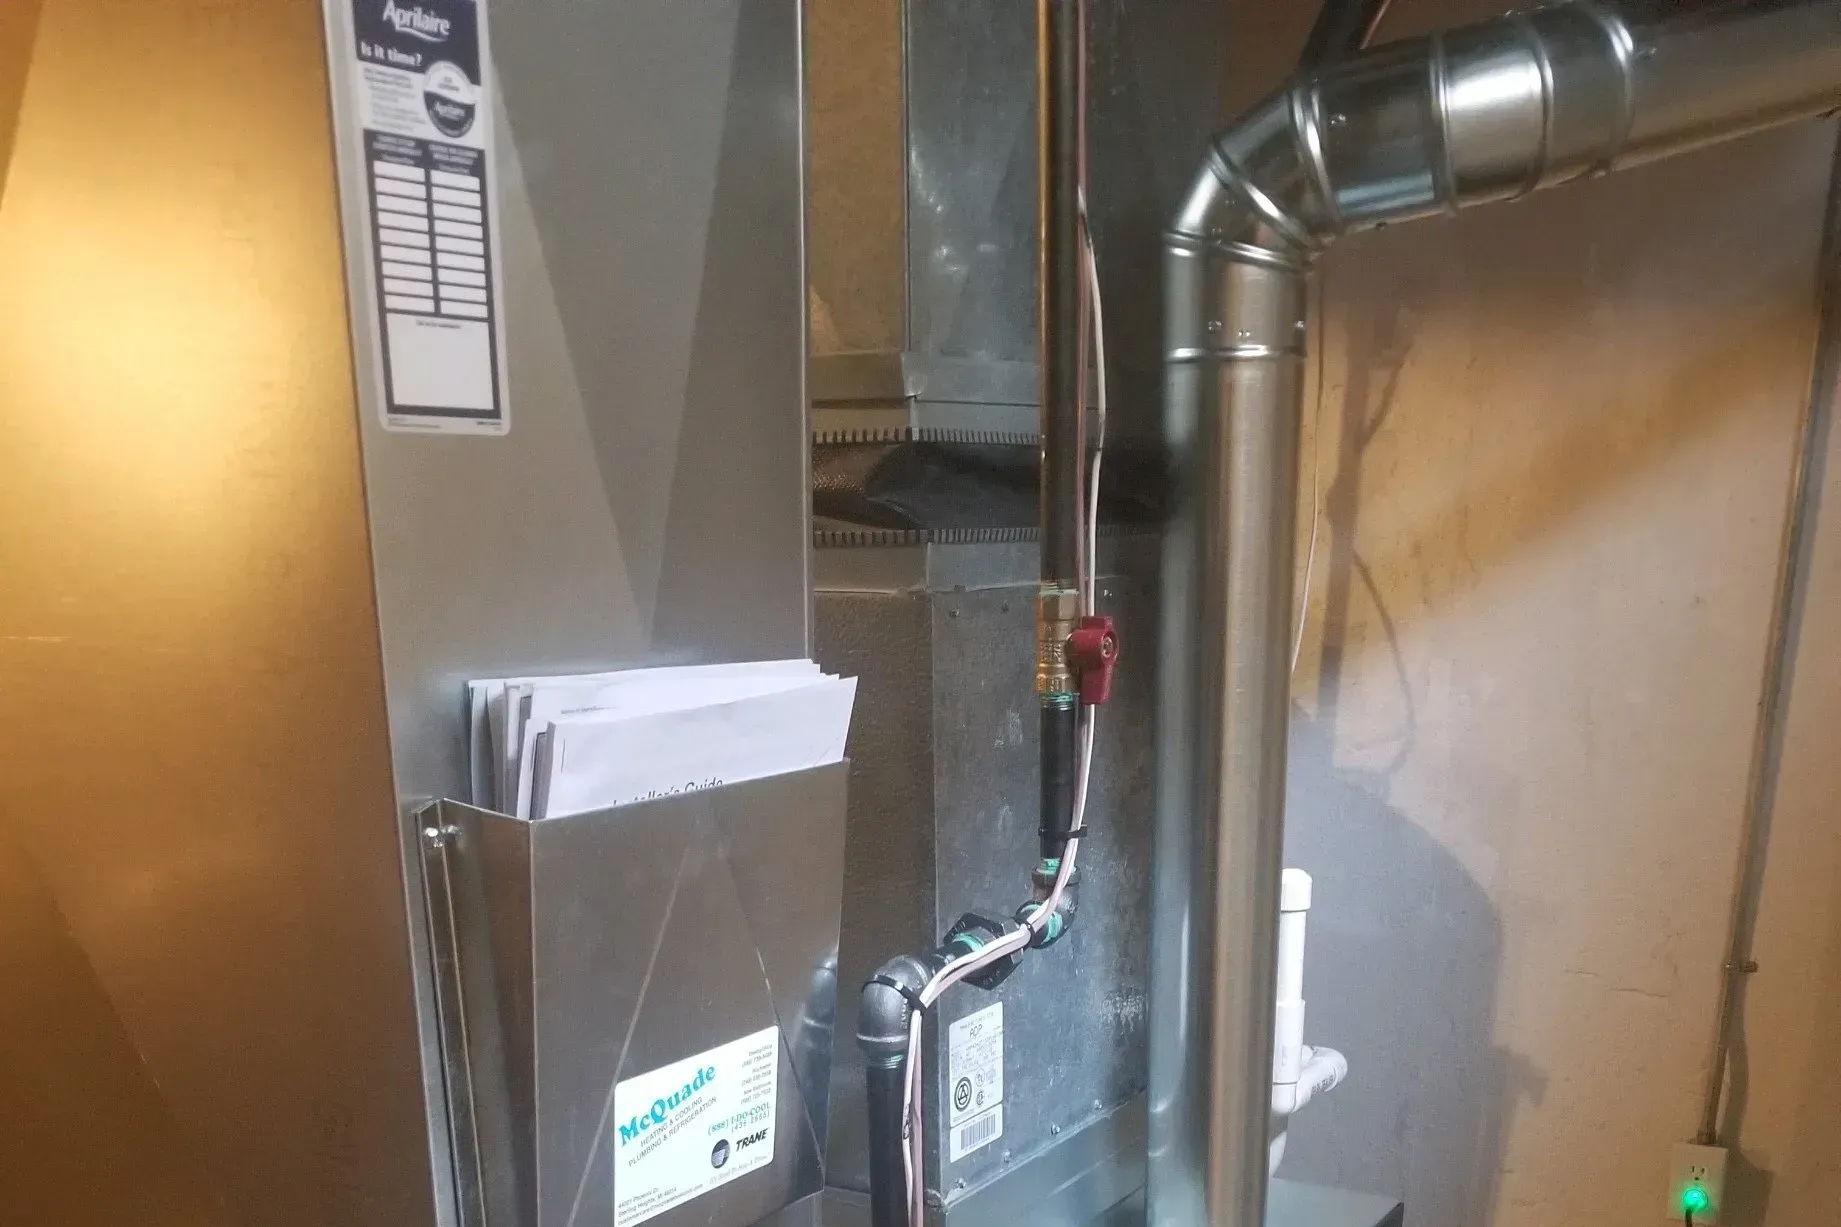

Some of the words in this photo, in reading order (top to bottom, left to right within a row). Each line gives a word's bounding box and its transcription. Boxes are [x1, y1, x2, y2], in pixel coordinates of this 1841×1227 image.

[383, 0, 451, 35] Aprilaire
[361, 41, 372, 57] Is
[374, 44, 385, 60] it
[387, 48, 422, 67] time?
[618, 1065, 716, 1147] McQuade
[640, 1122, 669, 1148] HEATING
[674, 1096, 703, 1122] COOLING
[628, 1139, 662, 1168] PLUMBING
[668, 1095, 717, 1138] REFRIGERATION
[736, 1127, 769, 1152] TRANE
